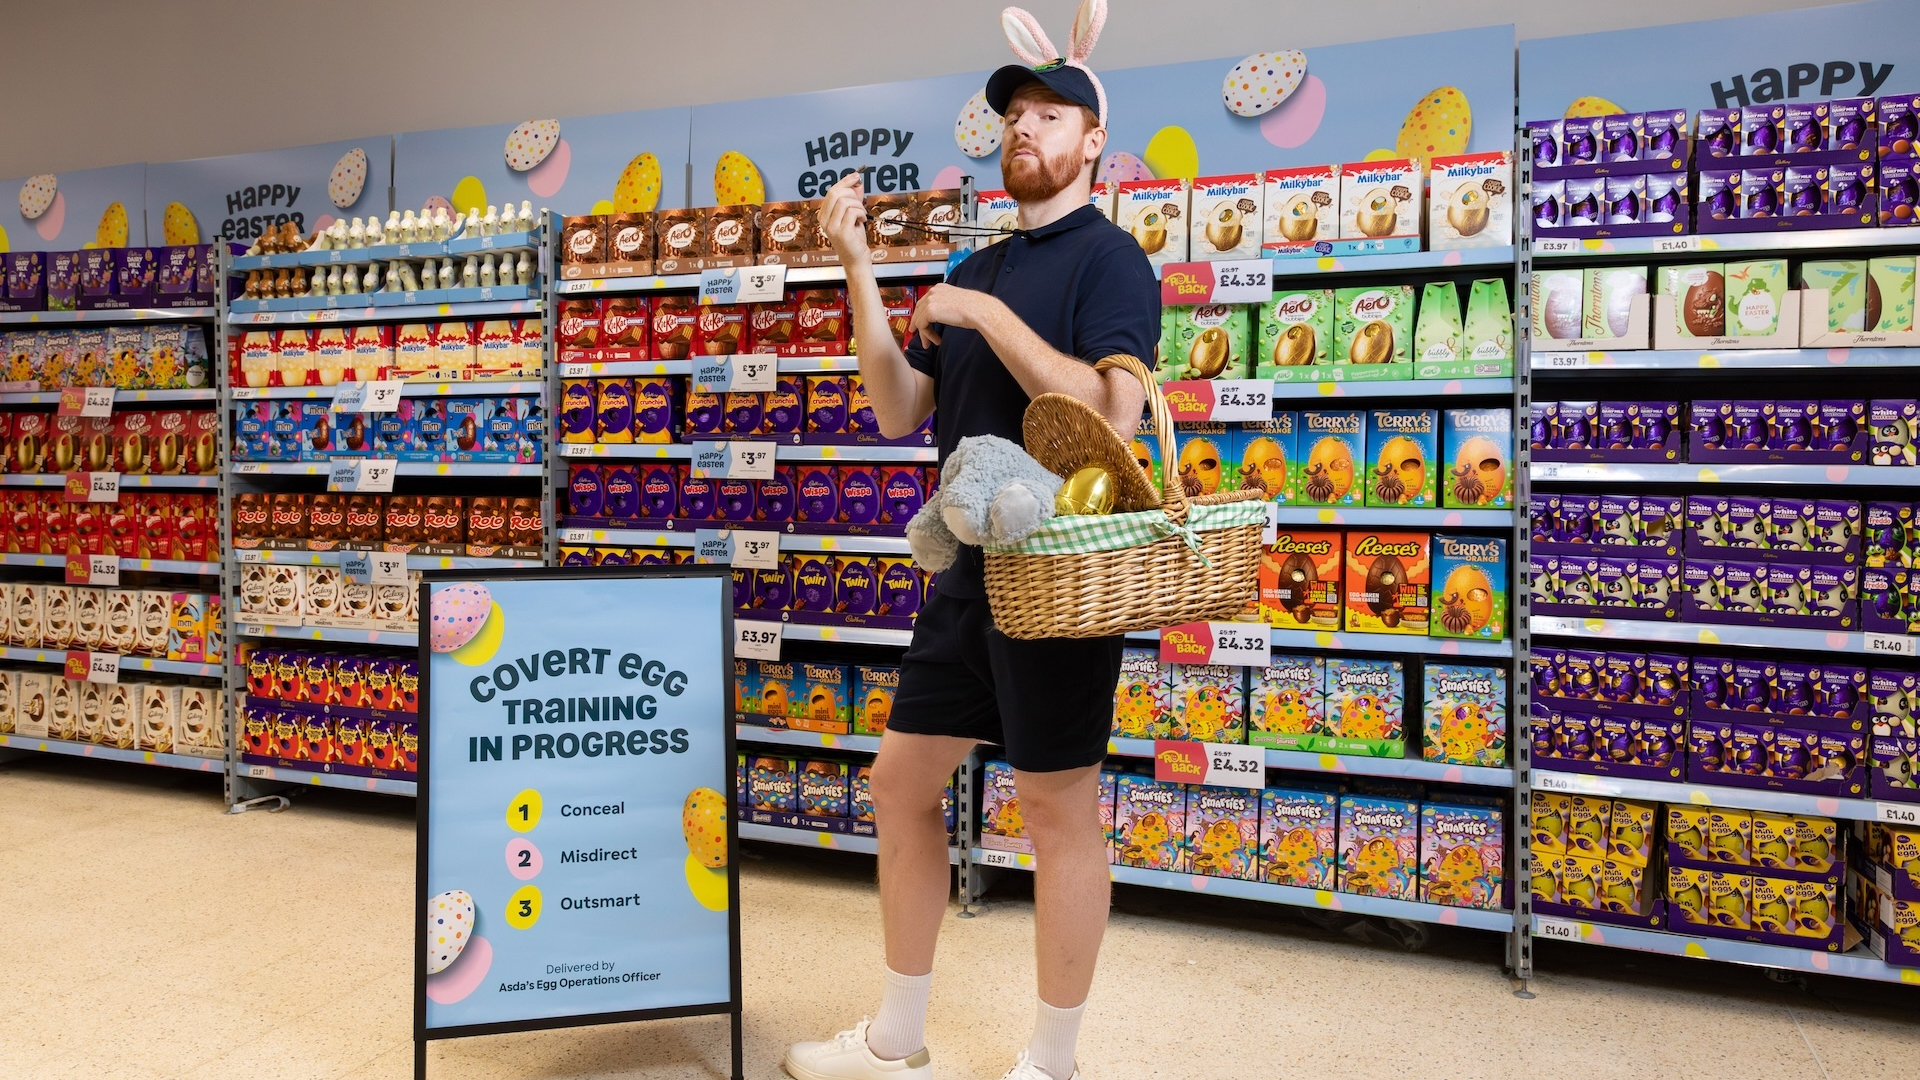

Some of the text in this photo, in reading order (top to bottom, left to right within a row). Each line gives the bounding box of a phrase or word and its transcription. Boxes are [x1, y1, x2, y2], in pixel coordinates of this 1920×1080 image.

[1447, 164, 1495, 178] Milkybar
[1279, 177, 1323, 191] Milkybar
[1357, 171, 1402, 185] Milkybar
[1132, 189, 1173, 202] Milkybar
[1206, 184, 1249, 198] Milkybar
[1543, 242, 1568, 251] £3.97
[1661, 241, 1688, 250] £1.40
[750, 275, 776, 288] £3.97
[1170, 273, 1197, 286] ROLL
[1220, 273, 1266, 288] £4.32
[570, 283, 586, 291] £3.97
[1278, 299, 1311, 316] Aero
[1355, 295, 1389, 314] Aero
[1552, 357, 1578, 366] £3.97
[569, 366, 585, 374] £3.97
[742, 364, 768, 377] £3.97
[374, 388, 395, 400] £3.97
[1170, 390, 1197, 404] ROLL
[1220, 393, 1266, 406] £4.32
[87, 398, 110, 407] £4.32
[565, 398, 588, 407] crunchie
[813, 397, 839, 406] crunchie
[1398, 426, 1430, 434] ORANGE
[571, 447, 587, 455] £3.97
[741, 451, 767, 465] £3.97
[368, 467, 389, 480] £3.97
[93, 482, 115, 491] £4.32
[574, 483, 597, 493] Wispa
[803, 486, 830, 497] Wispa
[569, 533, 585, 541] £3.97
[744, 540, 770, 554] £3.97
[1272, 536, 1330, 554] Reese's
[1357, 536, 1419, 557] Reese's
[1466, 555, 1499, 563] ORANGE
[93, 565, 115, 574] £4.32
[379, 561, 400, 574] £3.97
[1310, 581, 1326, 591] WIN
[1399, 584, 1416, 594] WIN
[742, 630, 777, 644] £3.97
[1168, 632, 1196, 645] ROLL
[1218, 636, 1264, 651] £4.32
[1873, 640, 1902, 652] £1.40
[93, 664, 115, 673] £4.32
[469, 736, 503, 762] IN
[1164, 752, 1191, 764] ROLL
[1213, 758, 1259, 773] £4.32
[518, 801, 625, 821] 1 Conceal
[1572, 811, 1592, 819] eggs
[1573, 805, 1590, 813] Mini
[1670, 818, 1688, 826] Mini
[1886, 811, 1914, 822] £1.40
[518, 847, 638, 867] 2 Misdirect
[987, 854, 1006, 864] £3.97
[518, 892, 641, 917] 3 Outsmart
[1545, 926, 1570, 936] £1.40
[546, 960, 615, 976] Delivered by
[499, 971, 661, 993] Asda's Egg Operations Officer
